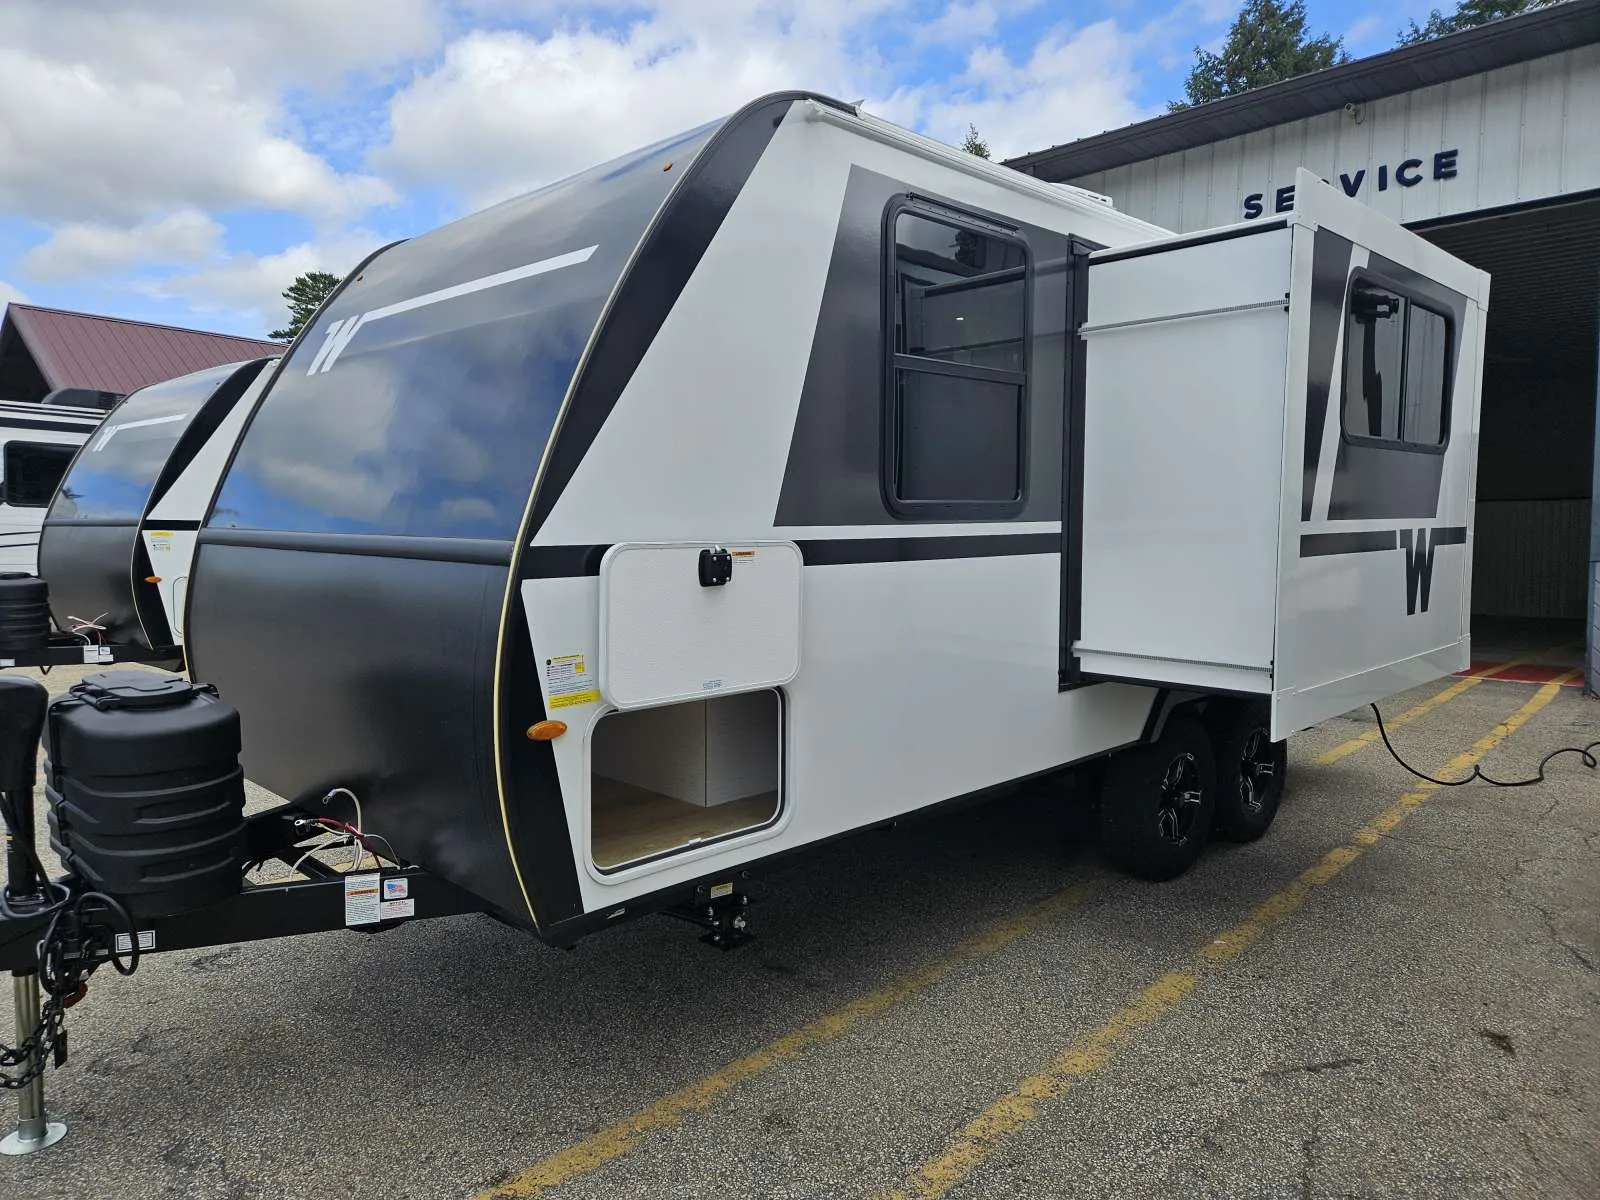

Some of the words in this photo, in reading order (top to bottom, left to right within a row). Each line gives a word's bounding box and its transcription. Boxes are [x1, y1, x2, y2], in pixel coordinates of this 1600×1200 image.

[1244, 149, 1458, 220] SEVICE
[306, 314, 366, 376] W
[1399, 527, 1436, 616] W
